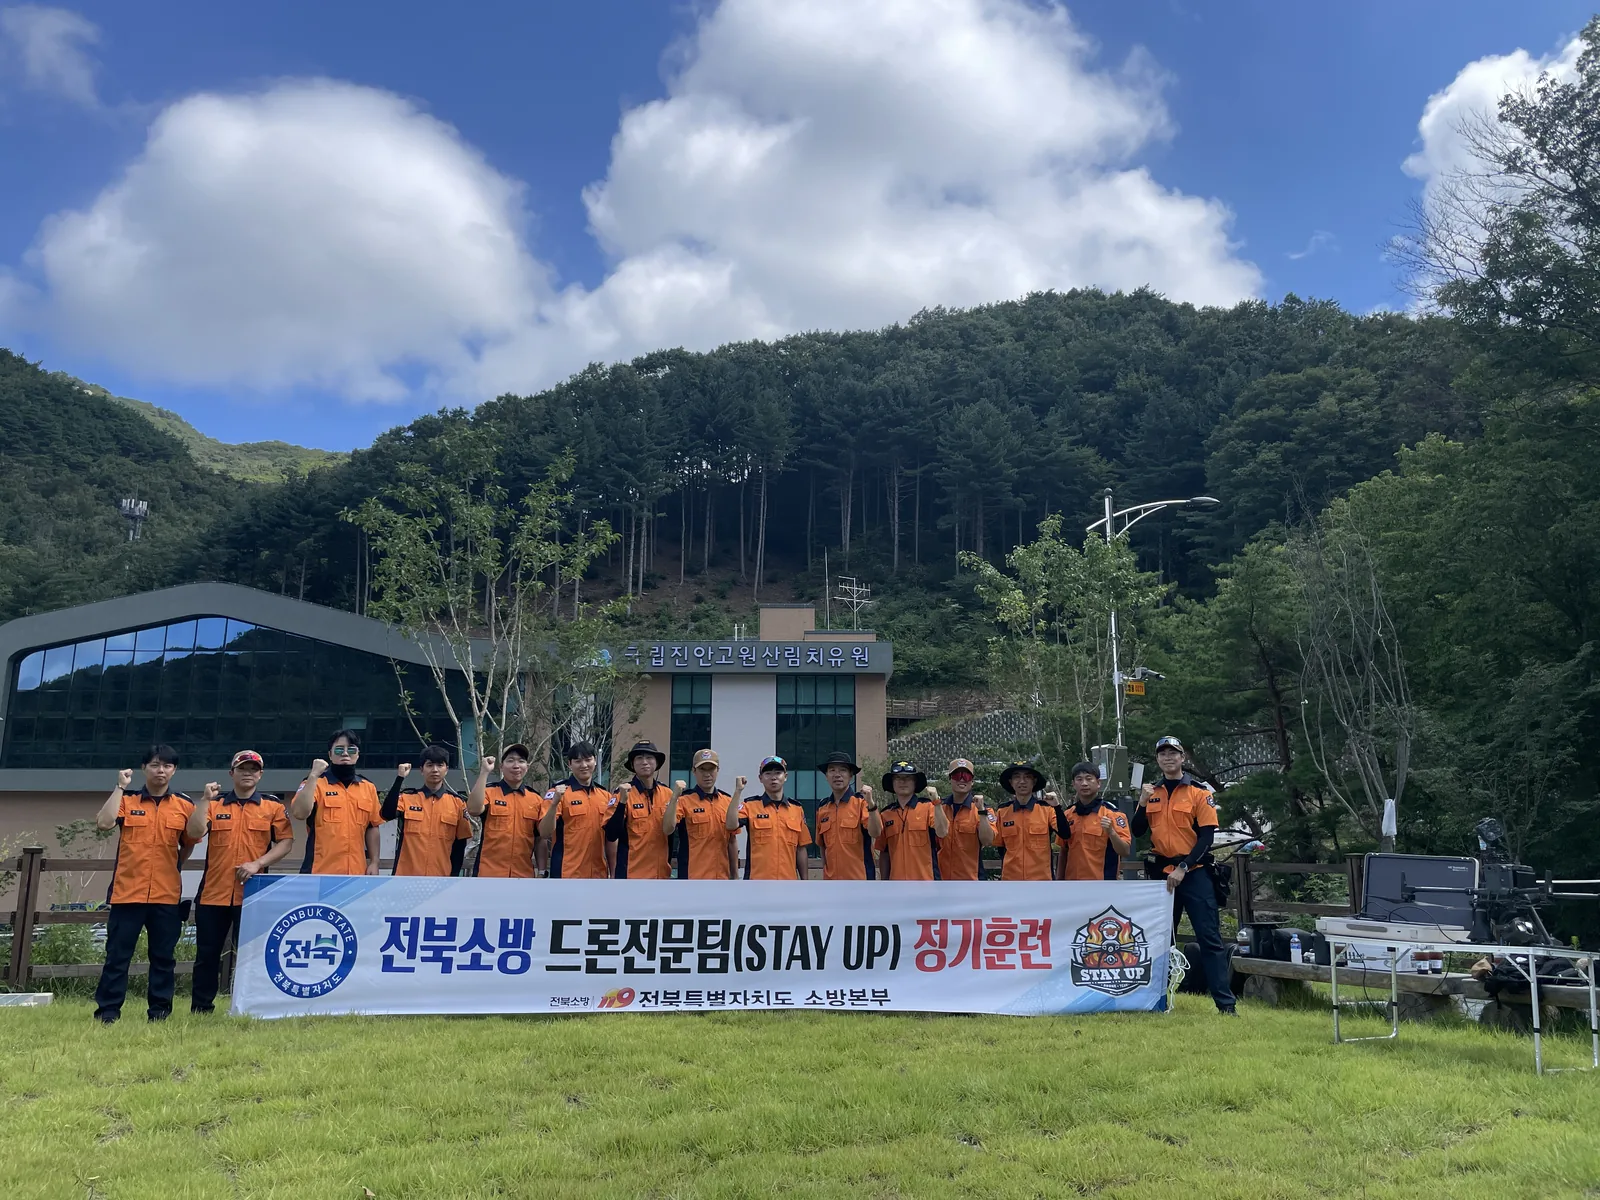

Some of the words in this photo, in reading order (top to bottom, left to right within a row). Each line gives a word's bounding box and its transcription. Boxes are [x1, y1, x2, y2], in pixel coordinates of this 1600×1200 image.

[272, 908, 323, 941] JEONBUK
[327, 911, 355, 943] STATE
[283, 934, 342, 969] 전북
[379, 916, 537, 975] 전북소방
[842, 924, 902, 971] UP)
[913, 917, 1053, 973] 정기훈련
[273, 971, 343, 997] 전북특별자치도
[1080, 968, 1121, 982] STAY
[1123, 967, 1145, 980] UP
[549, 996, 590, 1007] 전북소방
[597, 987, 636, 1009] 119
[638, 990, 795, 1008] 전북특별자치도
[803, 988, 891, 1007] 소방본부
